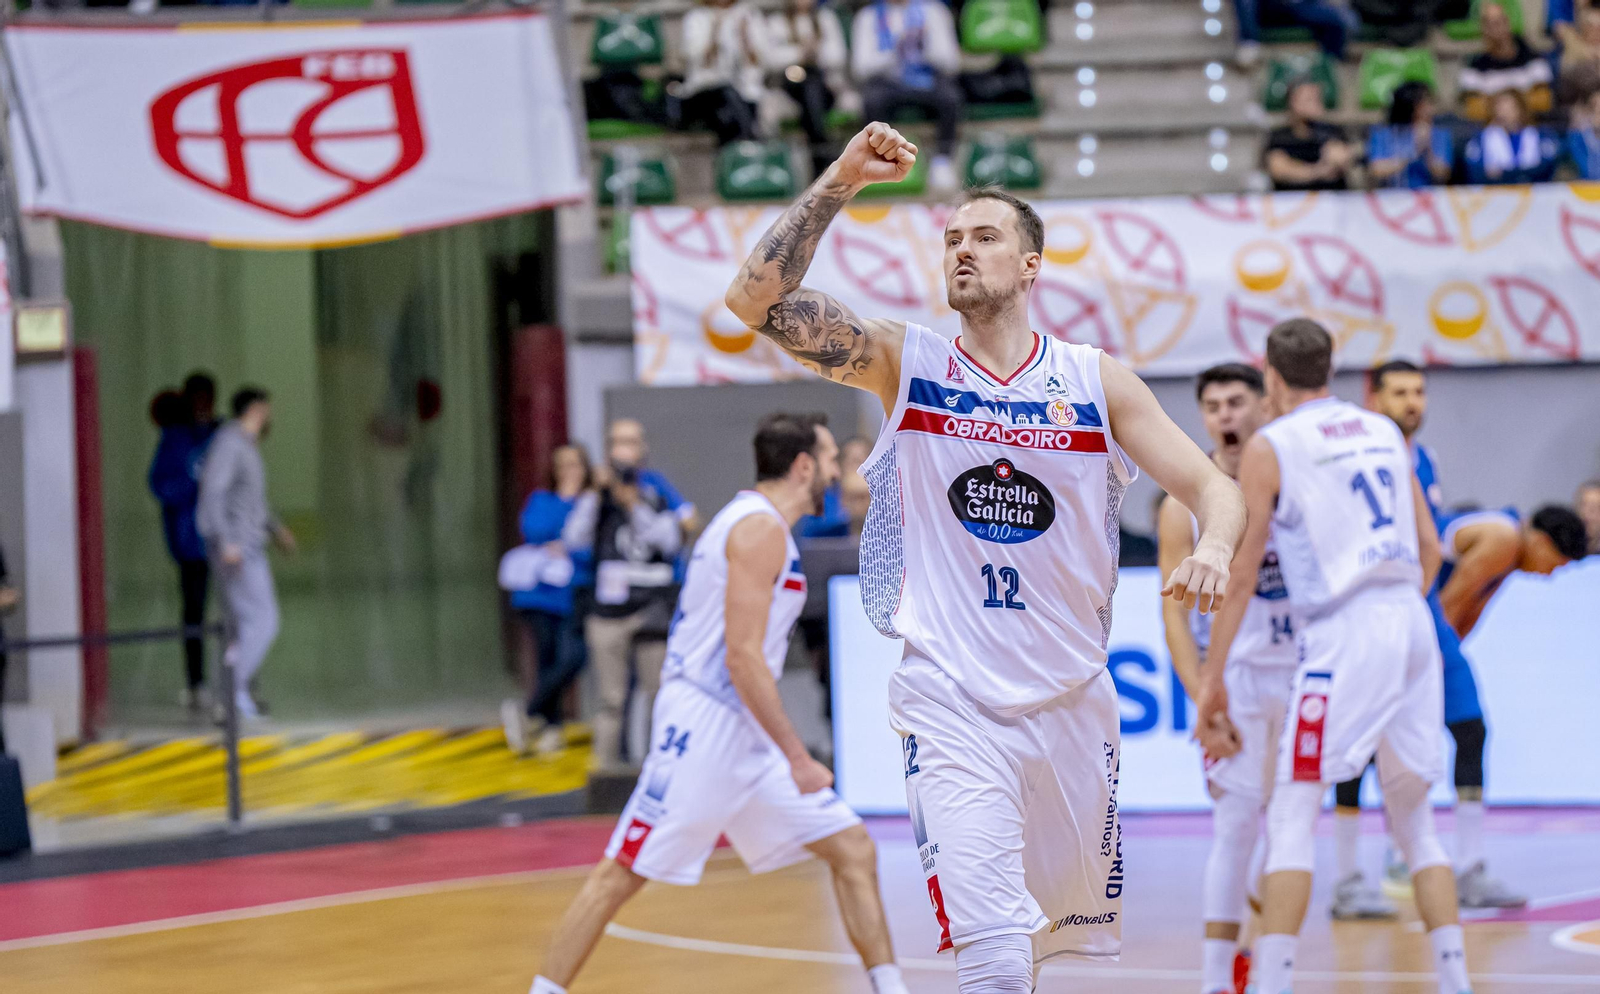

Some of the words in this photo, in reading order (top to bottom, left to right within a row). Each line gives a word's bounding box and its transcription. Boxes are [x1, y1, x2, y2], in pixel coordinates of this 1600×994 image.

[303, 53, 397, 79] FEB
[943, 417, 1072, 449] OBRADOIRO
[965, 477, 1039, 506] Estrella
[966, 498, 1034, 525] Galicia
[988, 522, 1011, 540] 0,0
[981, 563, 1026, 610] 12
[659, 725, 690, 757] 34
[929, 842, 940, 856] DE
[1056, 912, 1118, 930] MONBUS
